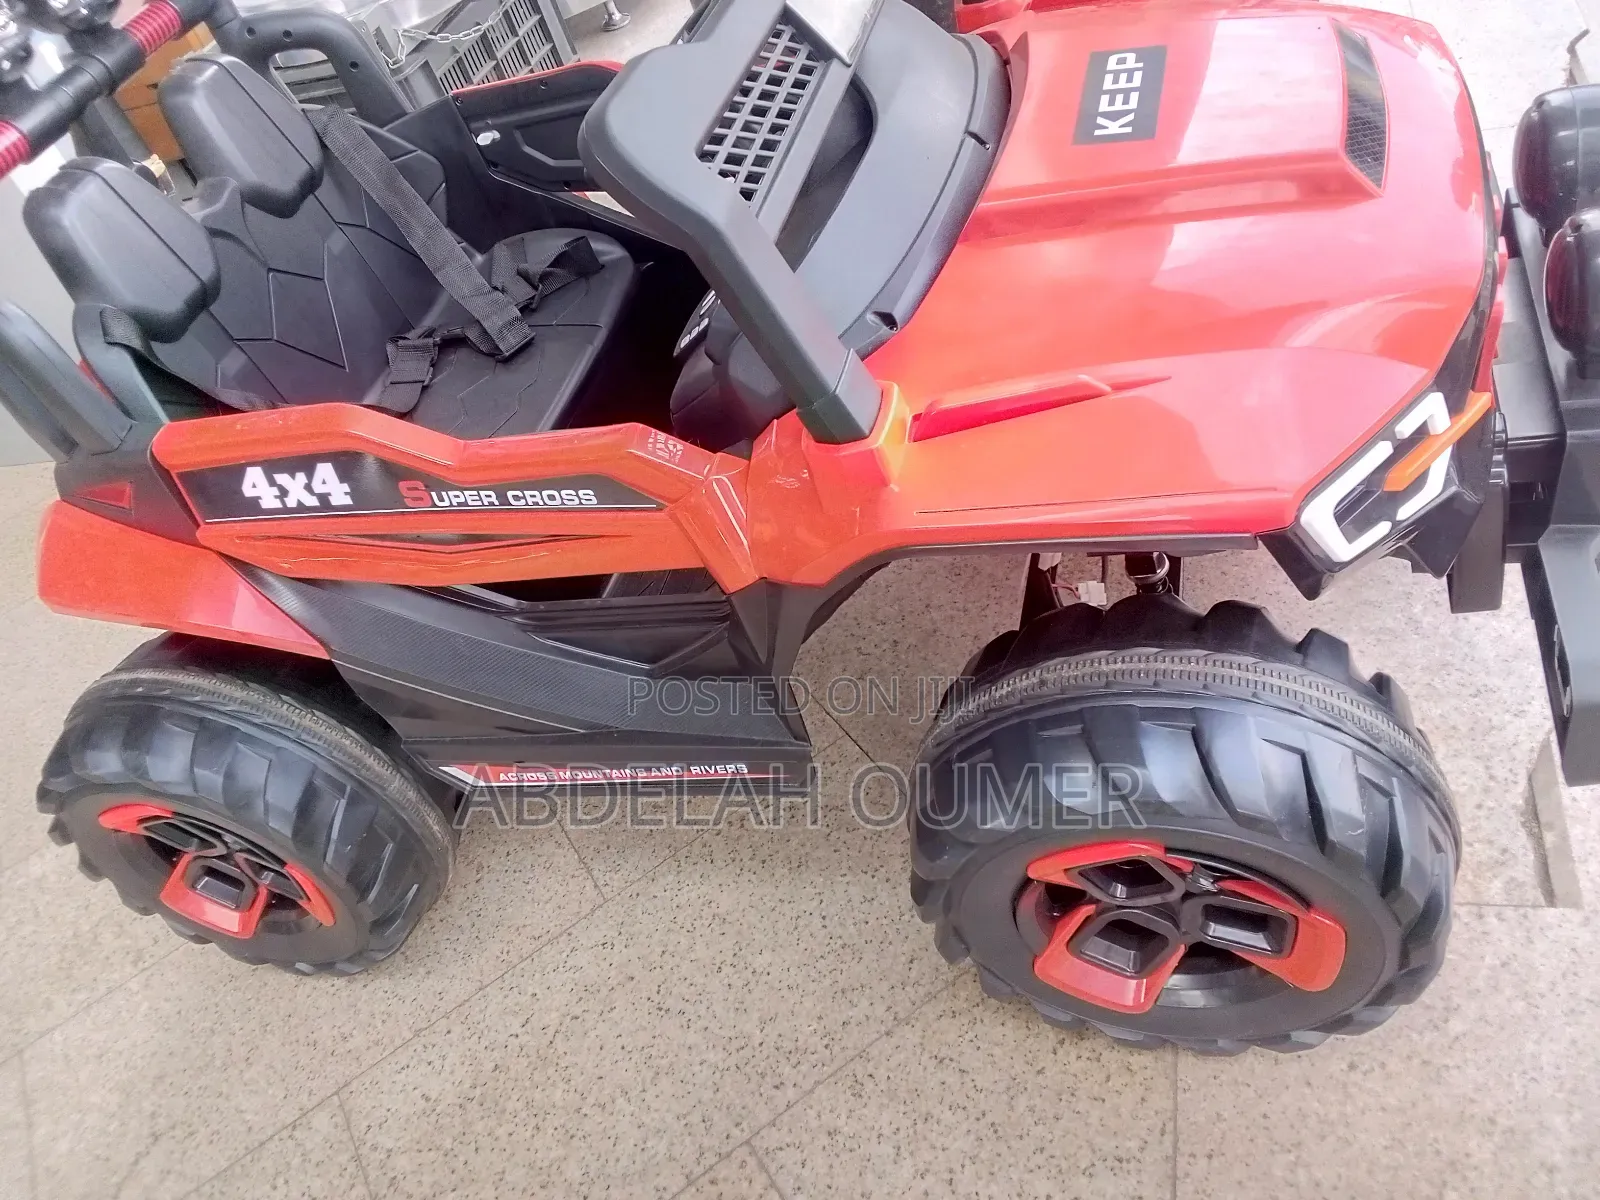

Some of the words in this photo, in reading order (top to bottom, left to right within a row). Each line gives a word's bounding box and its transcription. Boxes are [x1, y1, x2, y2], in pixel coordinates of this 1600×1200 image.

[1093, 52, 1144, 136] KEEP
[241, 462, 353, 509] 4x4
[398, 480, 499, 508] SUPER
[506, 489, 598, 506] CROSS
[499, 771, 557, 782] ACROSS
[558, 768, 647, 781] MOUNTAINS
[651, 766, 684, 777] AND
[690, 764, 748, 775] RIVERS
